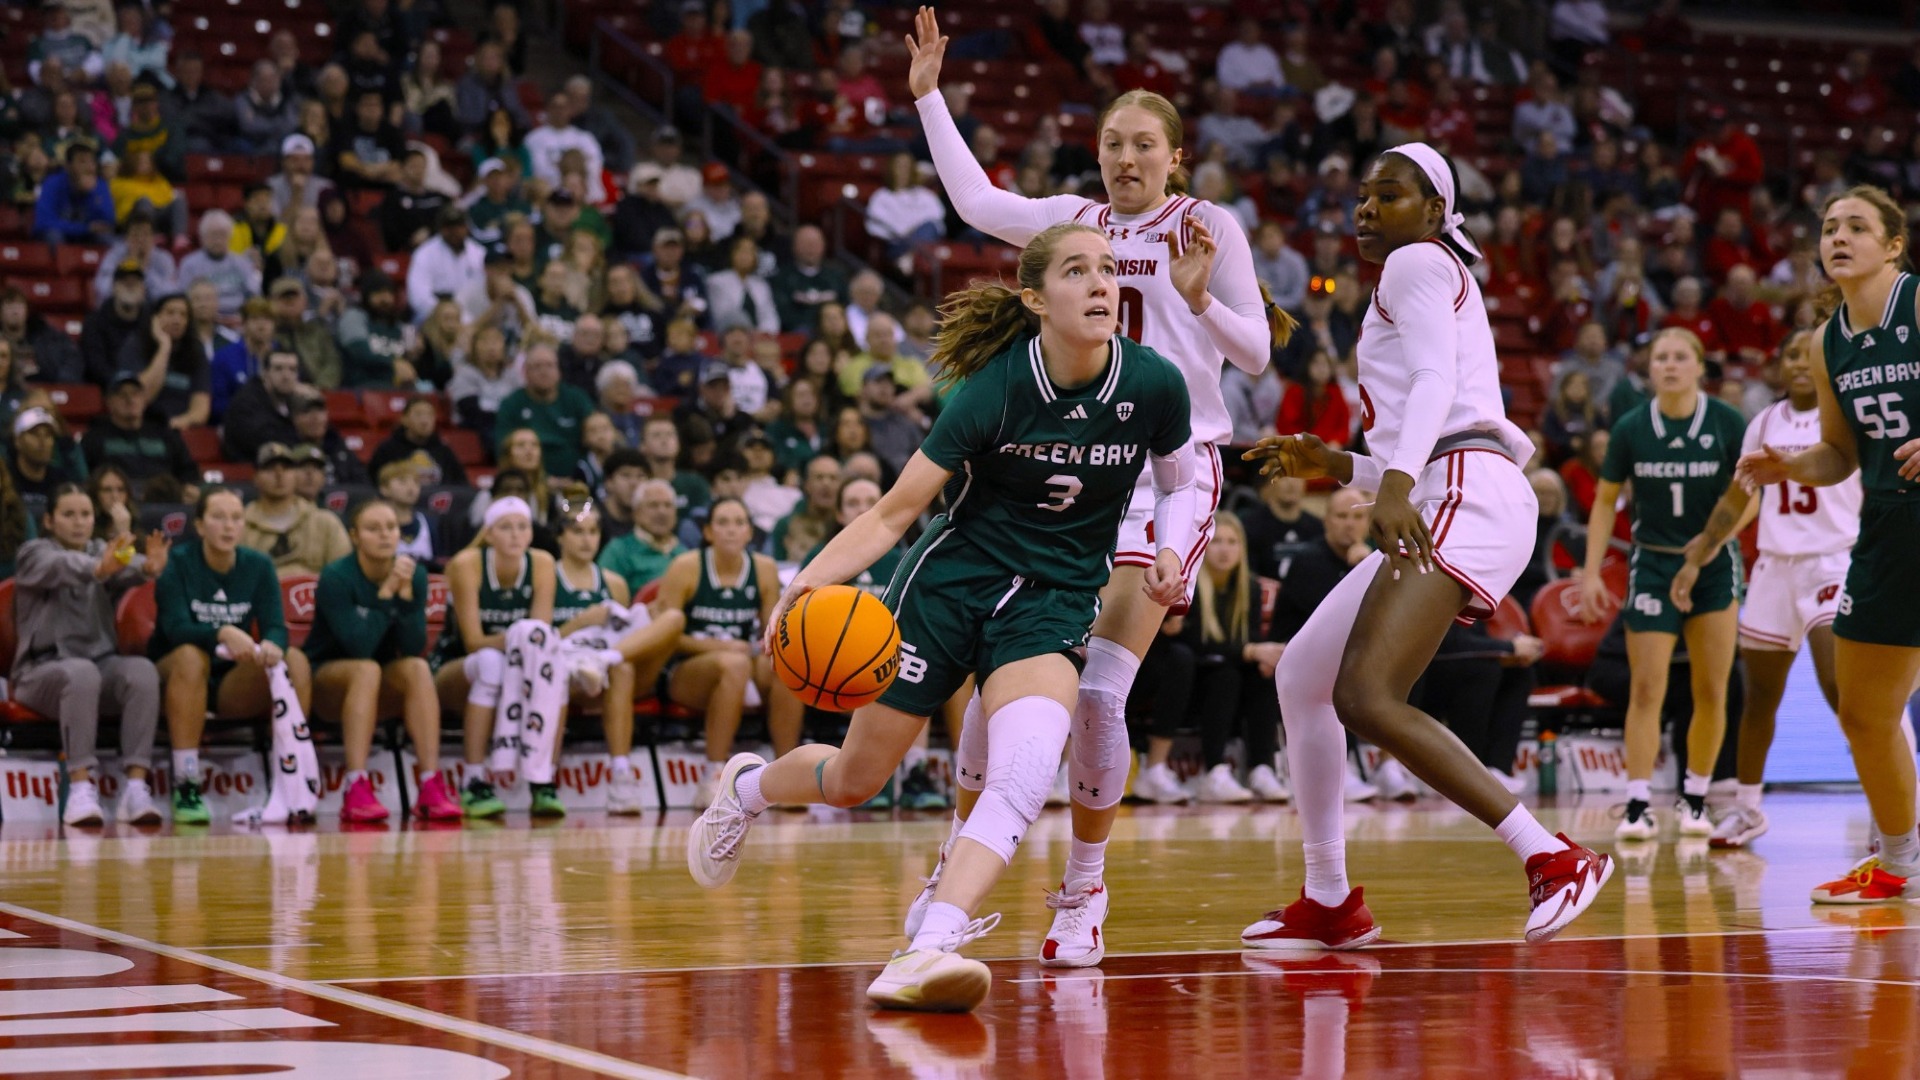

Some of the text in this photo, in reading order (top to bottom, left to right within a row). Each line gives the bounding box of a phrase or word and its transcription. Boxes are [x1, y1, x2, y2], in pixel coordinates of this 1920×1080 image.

[1115, 259, 1158, 276] NSIN
[1835, 361, 1920, 393] GREEN BAY
[1853, 392, 1911, 439] 55
[1000, 443, 1138, 466] GREEN BAY
[1634, 460, 1720, 478] GREEN BAY
[1037, 474, 1084, 512] 3
[1670, 482, 1684, 517] 1
[1839, 592, 1854, 616] B
[873, 644, 900, 683] Wil
